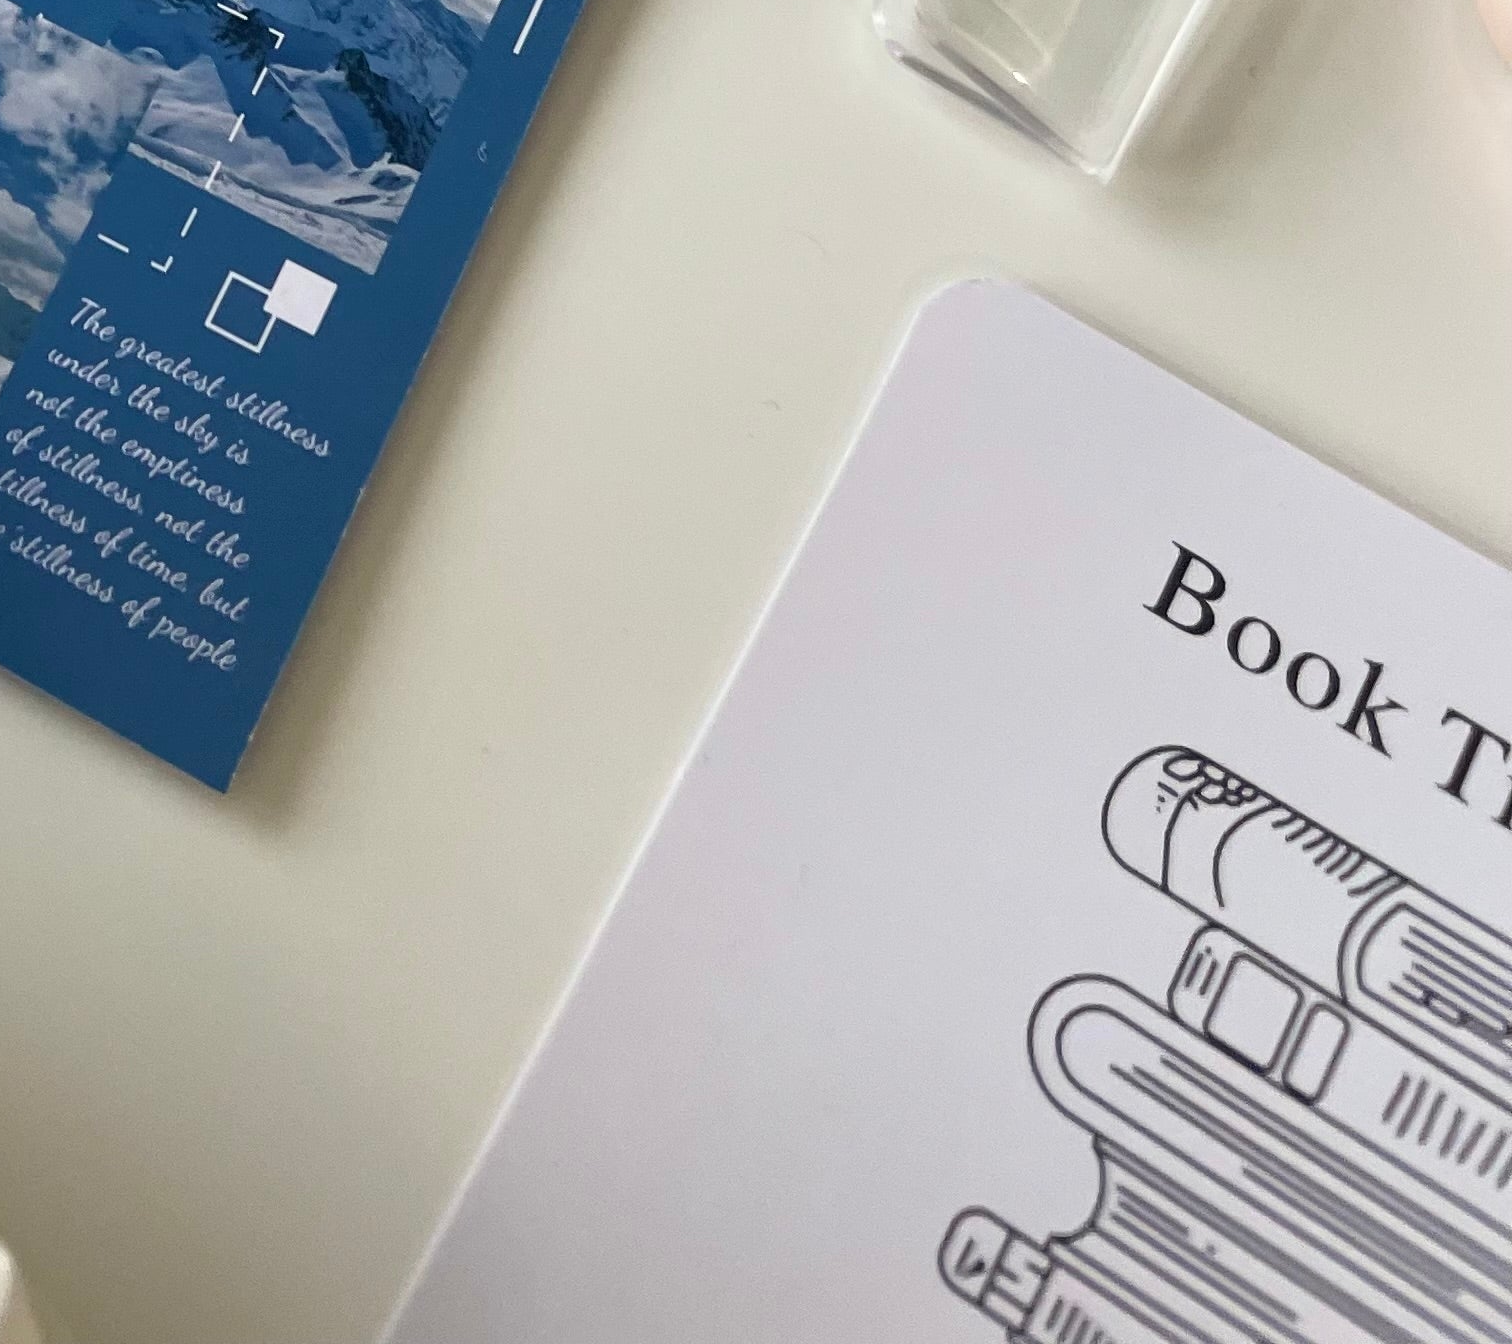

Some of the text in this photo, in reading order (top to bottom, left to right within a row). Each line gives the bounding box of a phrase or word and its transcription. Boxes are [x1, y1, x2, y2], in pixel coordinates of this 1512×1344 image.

[47, 346, 251, 466] under the sky is
[69, 296, 332, 458] The greatest stillness
[5, 423, 46, 456] of
[154, 511, 208, 544] not
[205, 530, 251, 570] the
[25, 386, 247, 516] not the emptiness
[8, 534, 116, 605] stillness
[120, 595, 163, 629] of
[147, 613, 240, 672] people
[93, 526, 134, 559] of
[198, 577, 251, 623] but
[1141, 539, 1410, 761] Book
